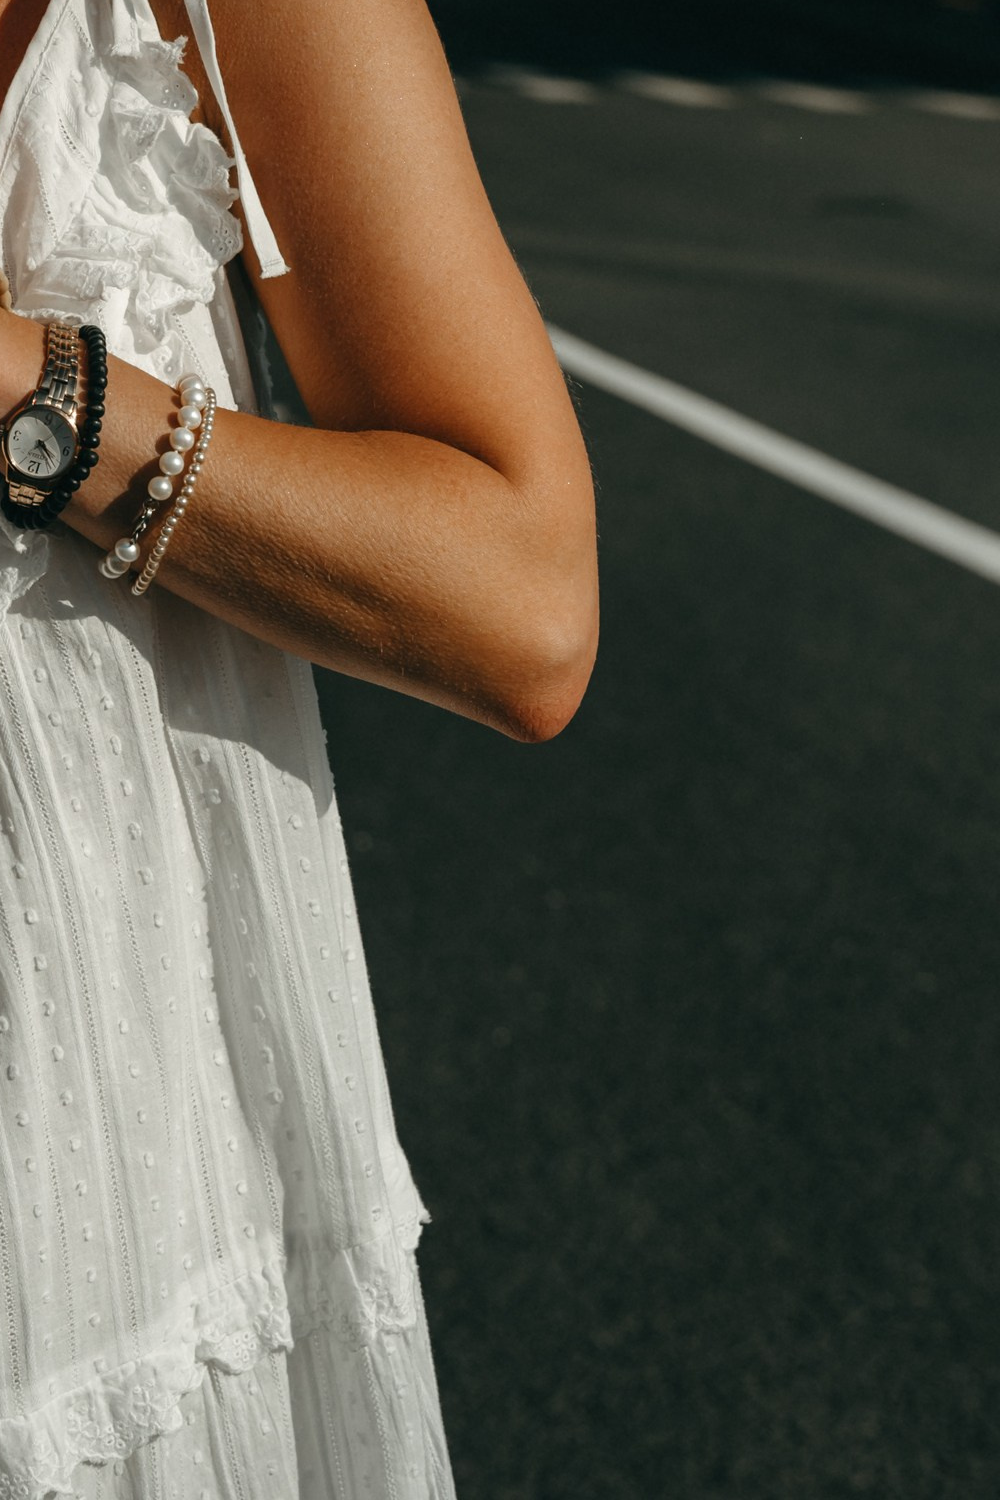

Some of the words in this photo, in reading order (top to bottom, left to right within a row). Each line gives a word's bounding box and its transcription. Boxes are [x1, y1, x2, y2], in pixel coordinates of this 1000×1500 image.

[13, 430, 21, 441] 3
[62, 446, 71, 457] 9
[27, 461, 41, 474] 12
